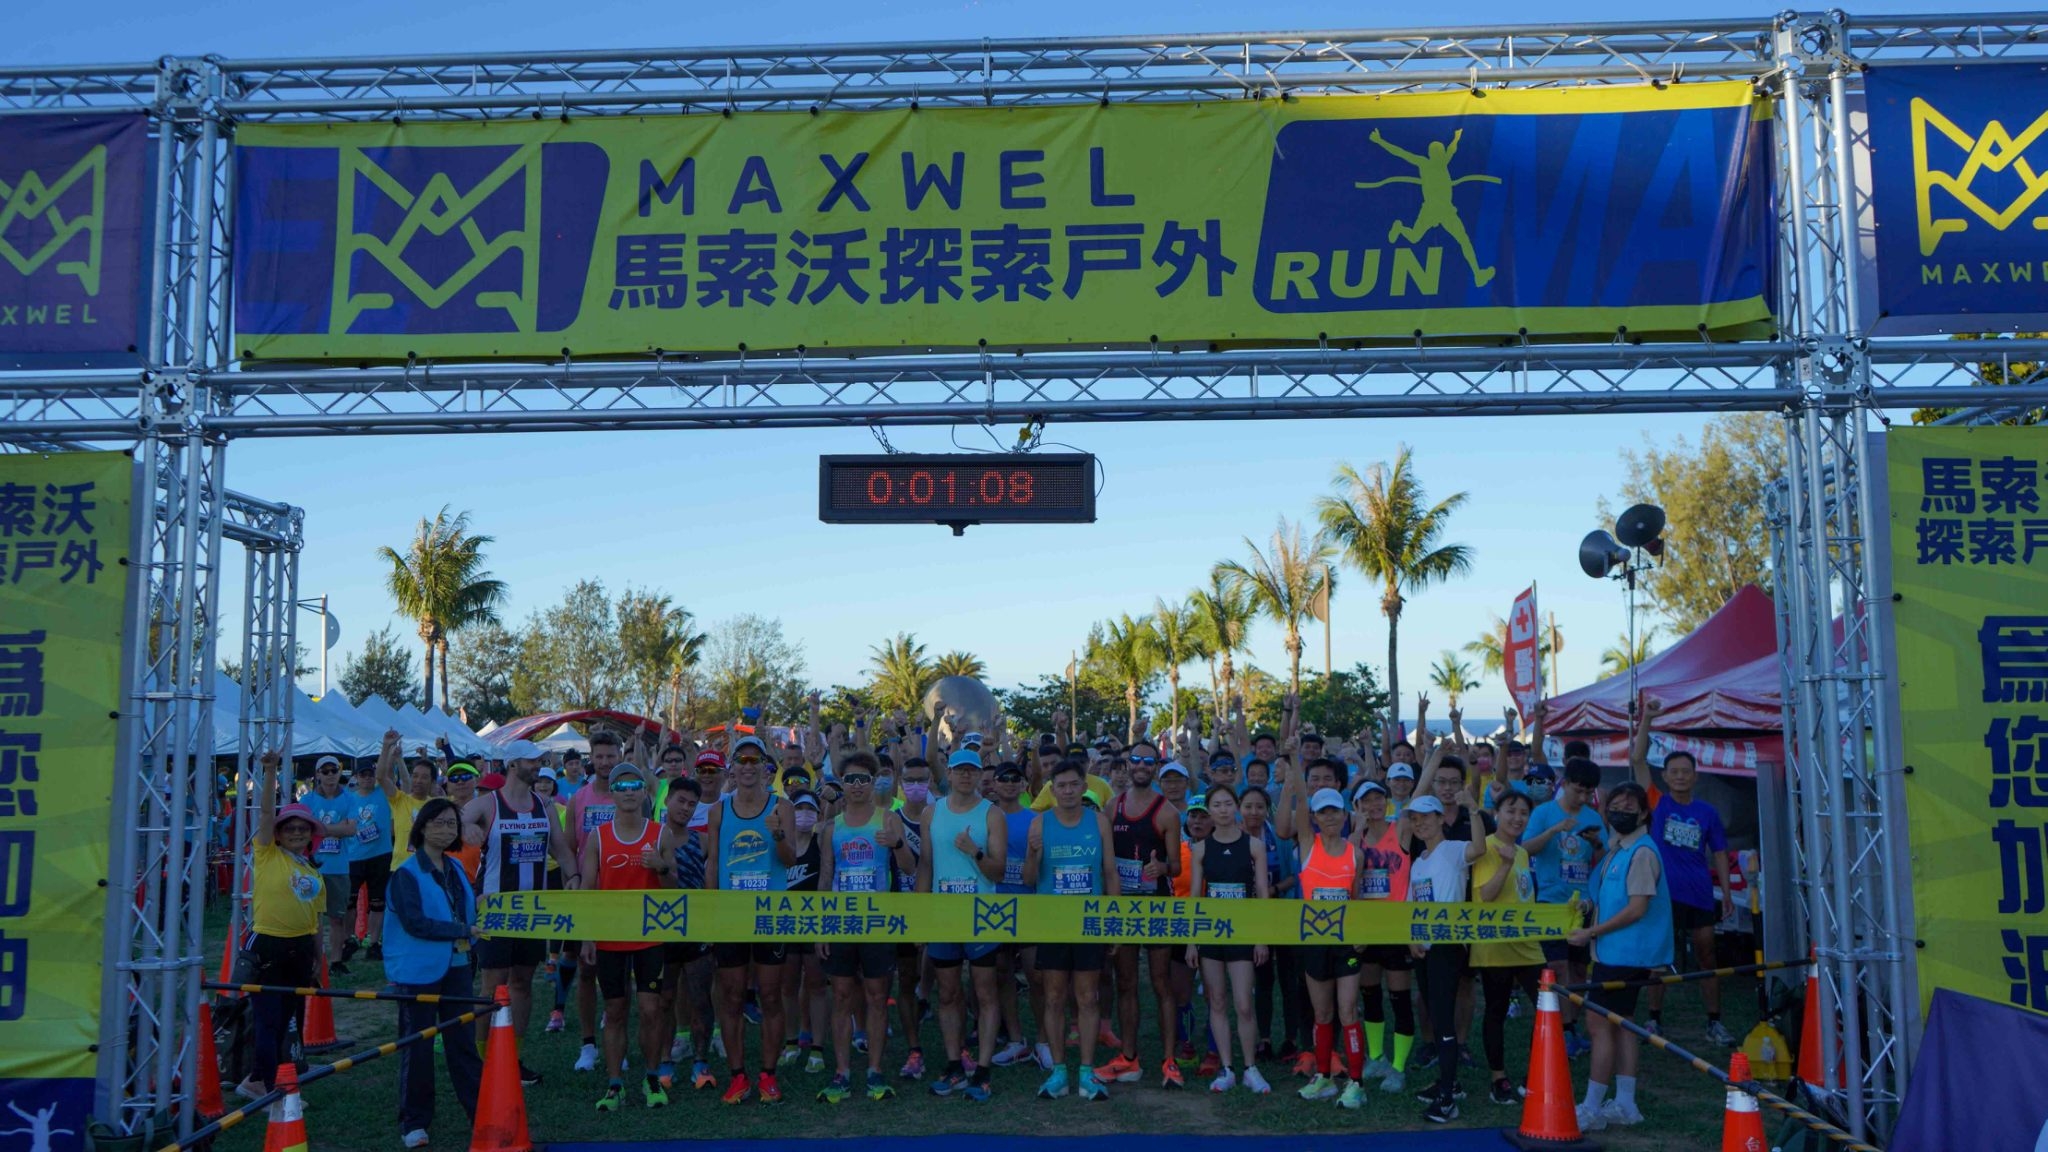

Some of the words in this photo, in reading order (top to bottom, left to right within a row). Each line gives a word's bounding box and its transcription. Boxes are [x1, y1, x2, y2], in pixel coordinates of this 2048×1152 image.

[638, 147, 1135, 217] MAXWEL
[608, 219, 1238, 311] 馬索沃探索戶外
[1270, 247, 1443, 300] RUN
[867, 471, 1034, 505] 0:01:08
[1920, 456, 2048, 514] 馬索
[0, 539, 104, 585] 戶外
[743, 879, 768, 888] 10230
[849, 875, 874, 884] 10034
[1066, 873, 1089, 882] 10071
[951, 885, 975, 893] 10045
[756, 896, 879, 911] MAXWEL
[1084, 900, 1207, 915] MAXWEL
[754, 915, 908, 936] 馬索沃探索戶外
[1412, 908, 1536, 922] MAXWEL
[1082, 916, 1234, 938] 馬索沃探索戶外
